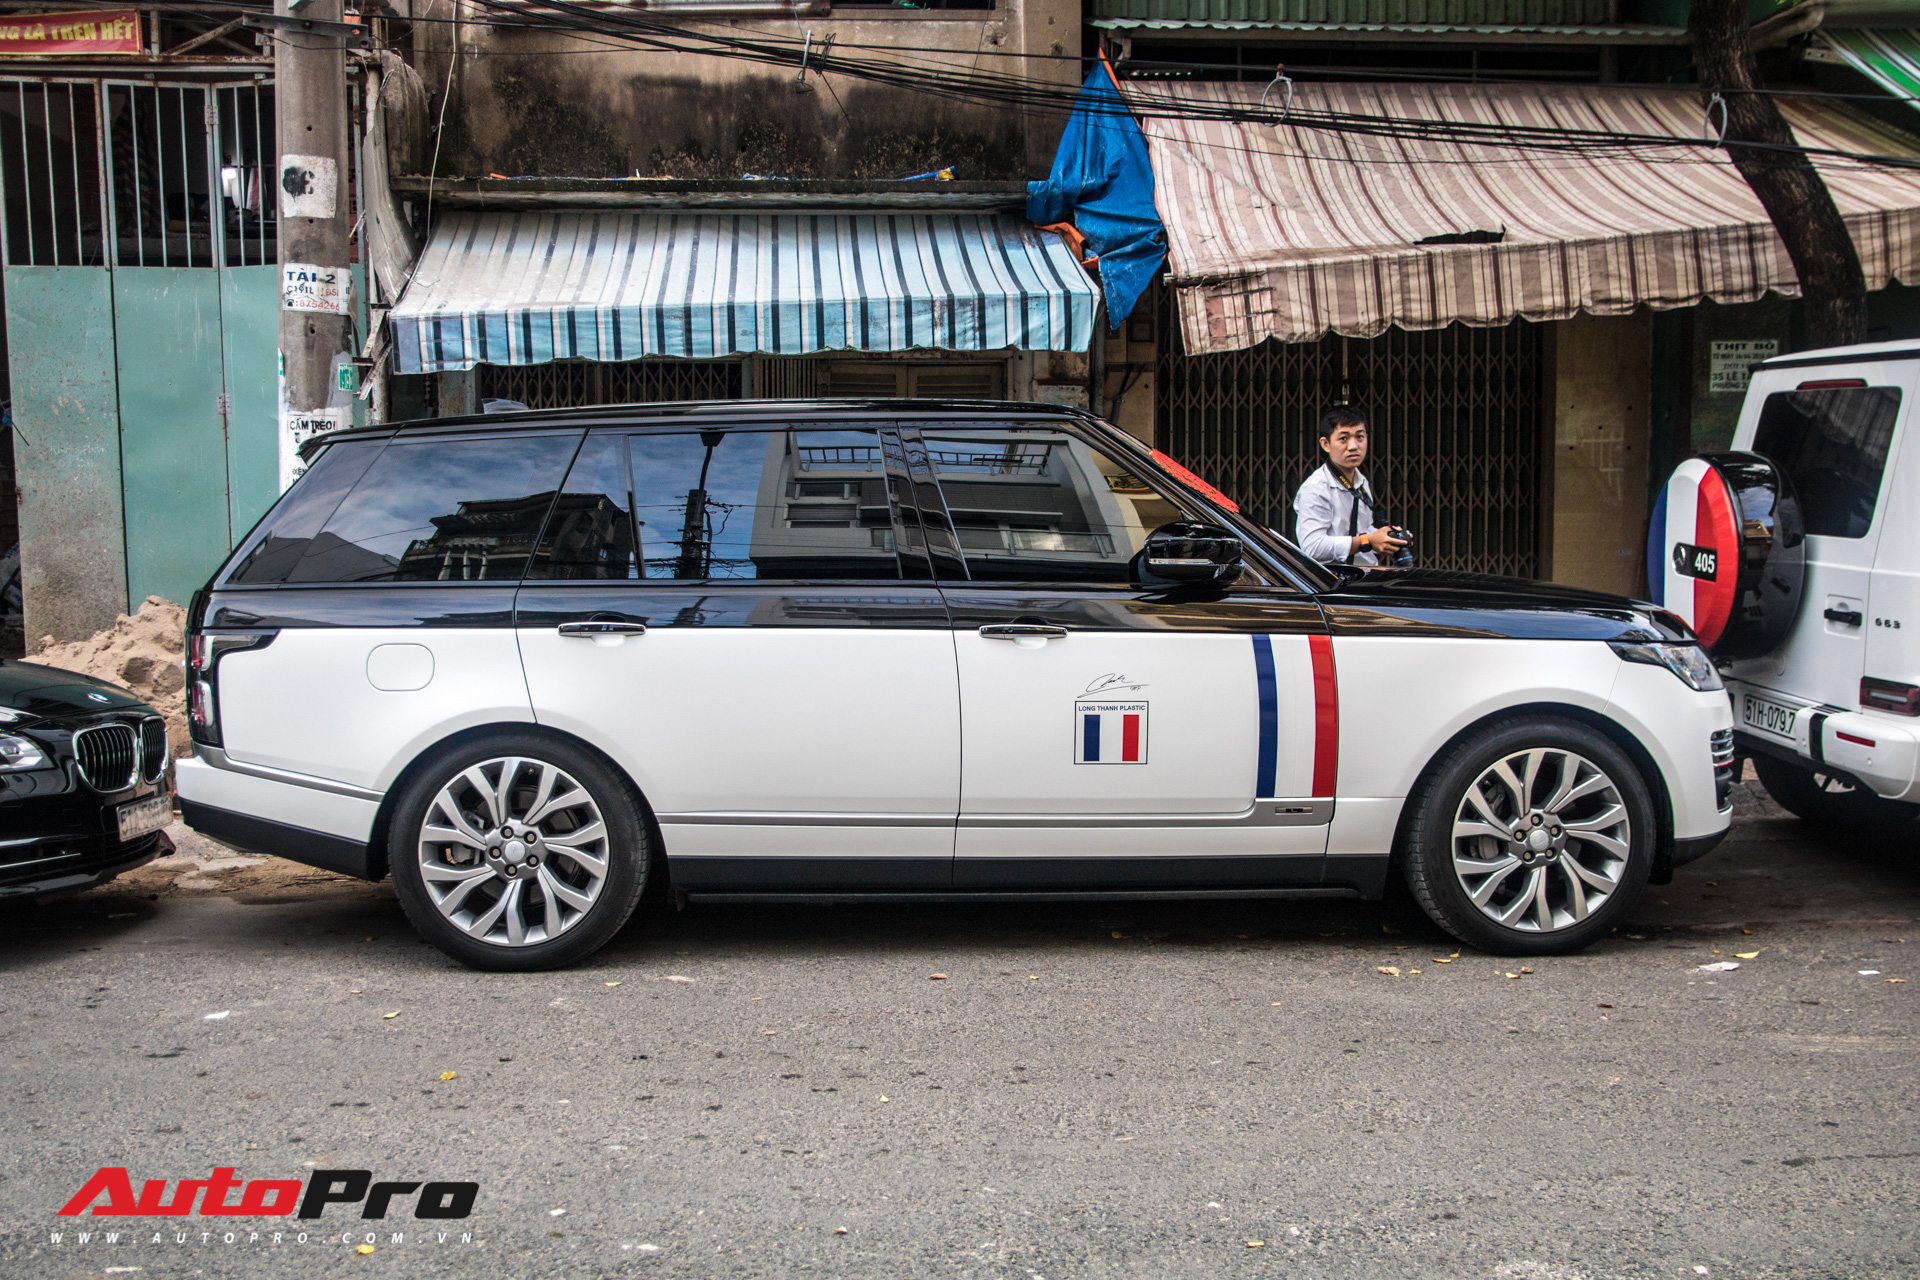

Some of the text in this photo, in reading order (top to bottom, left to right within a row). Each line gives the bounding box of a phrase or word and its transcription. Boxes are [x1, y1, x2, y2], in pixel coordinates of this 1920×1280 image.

[24, 23, 46, 40] LÀ
[100, 16, 134, 40] HẾT
[325, 273, 336, 285] 2
[1715, 343, 1748, 351] THỊT
[290, 417, 309, 430] CẤM
[1694, 551, 1716, 574] 405
[1745, 698, 1797, 735] 51H-079.7
